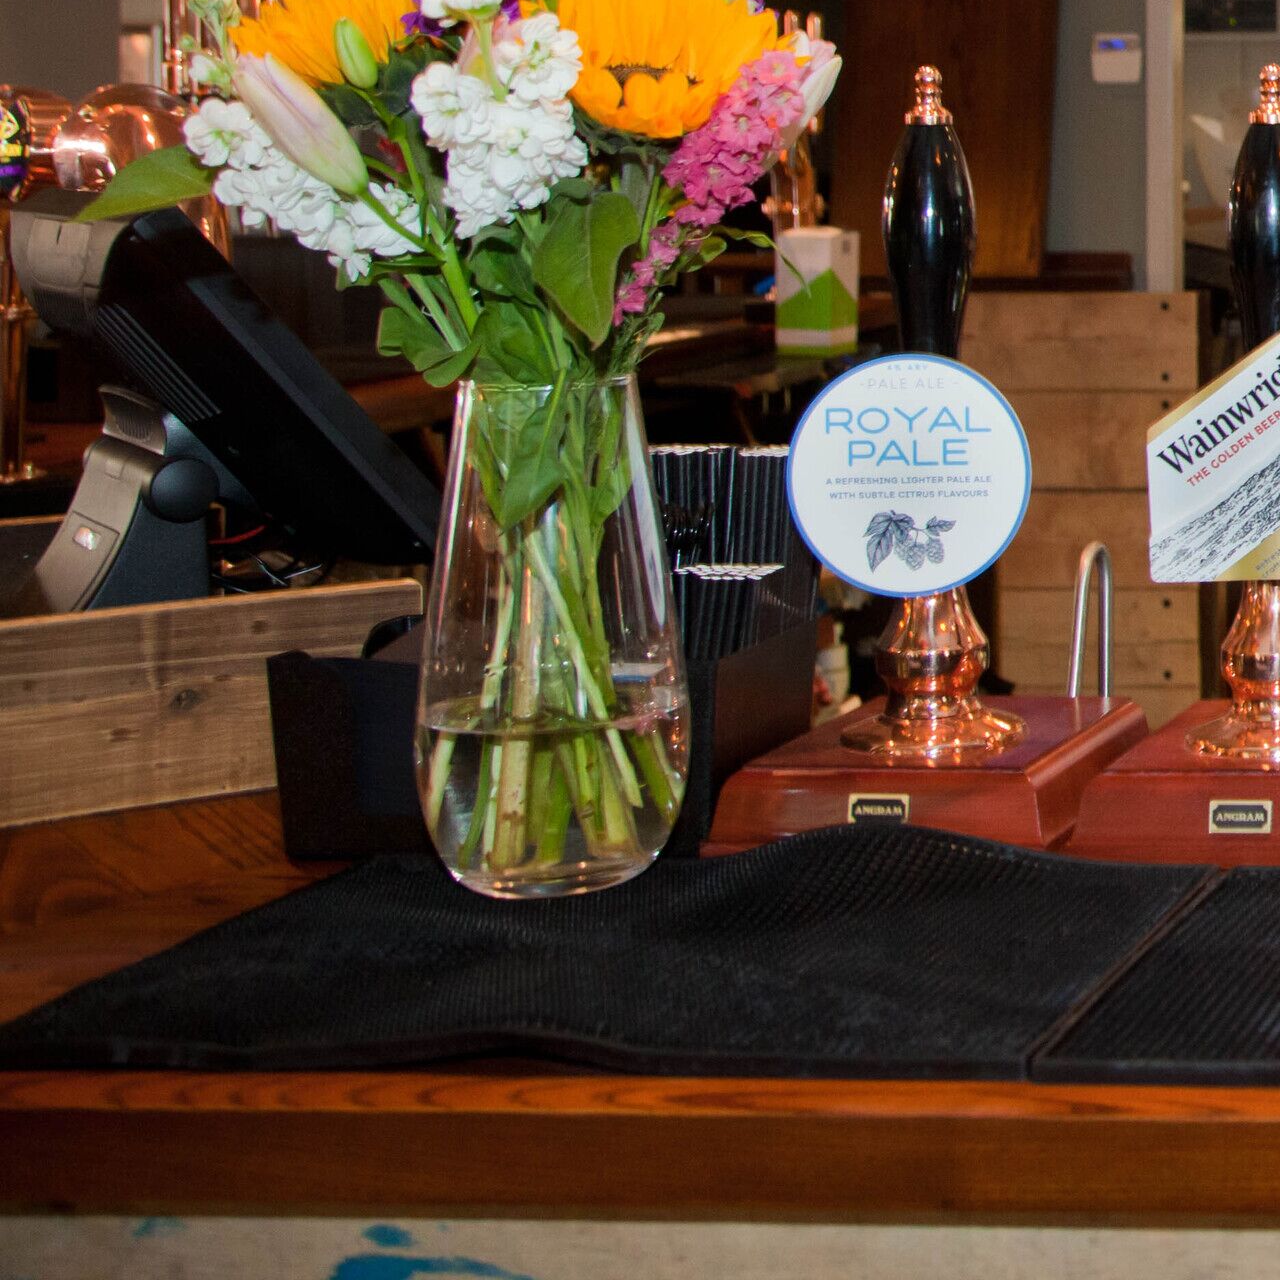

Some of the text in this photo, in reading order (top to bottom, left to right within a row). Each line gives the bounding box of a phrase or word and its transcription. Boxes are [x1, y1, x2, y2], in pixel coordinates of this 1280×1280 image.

[867, 378, 945, 389] PALE ALE
[825, 406, 992, 434] ROYAL
[848, 438, 969, 467] PALE
[1187, 467, 1211, 488] THE
[1211, 434, 1255, 470] GOLDEN
[825, 477, 833, 485] A
[835, 477, 898, 485] REFRESHING
[901, 476, 944, 484] LIGHTER
[974, 475, 992, 483] ALE
[829, 489, 989, 500] WITH SUBTLE CITRUS FLAVOURS
[854, 805, 903, 816] ANGRAM
[1215, 811, 1265, 822] ANGRAM
